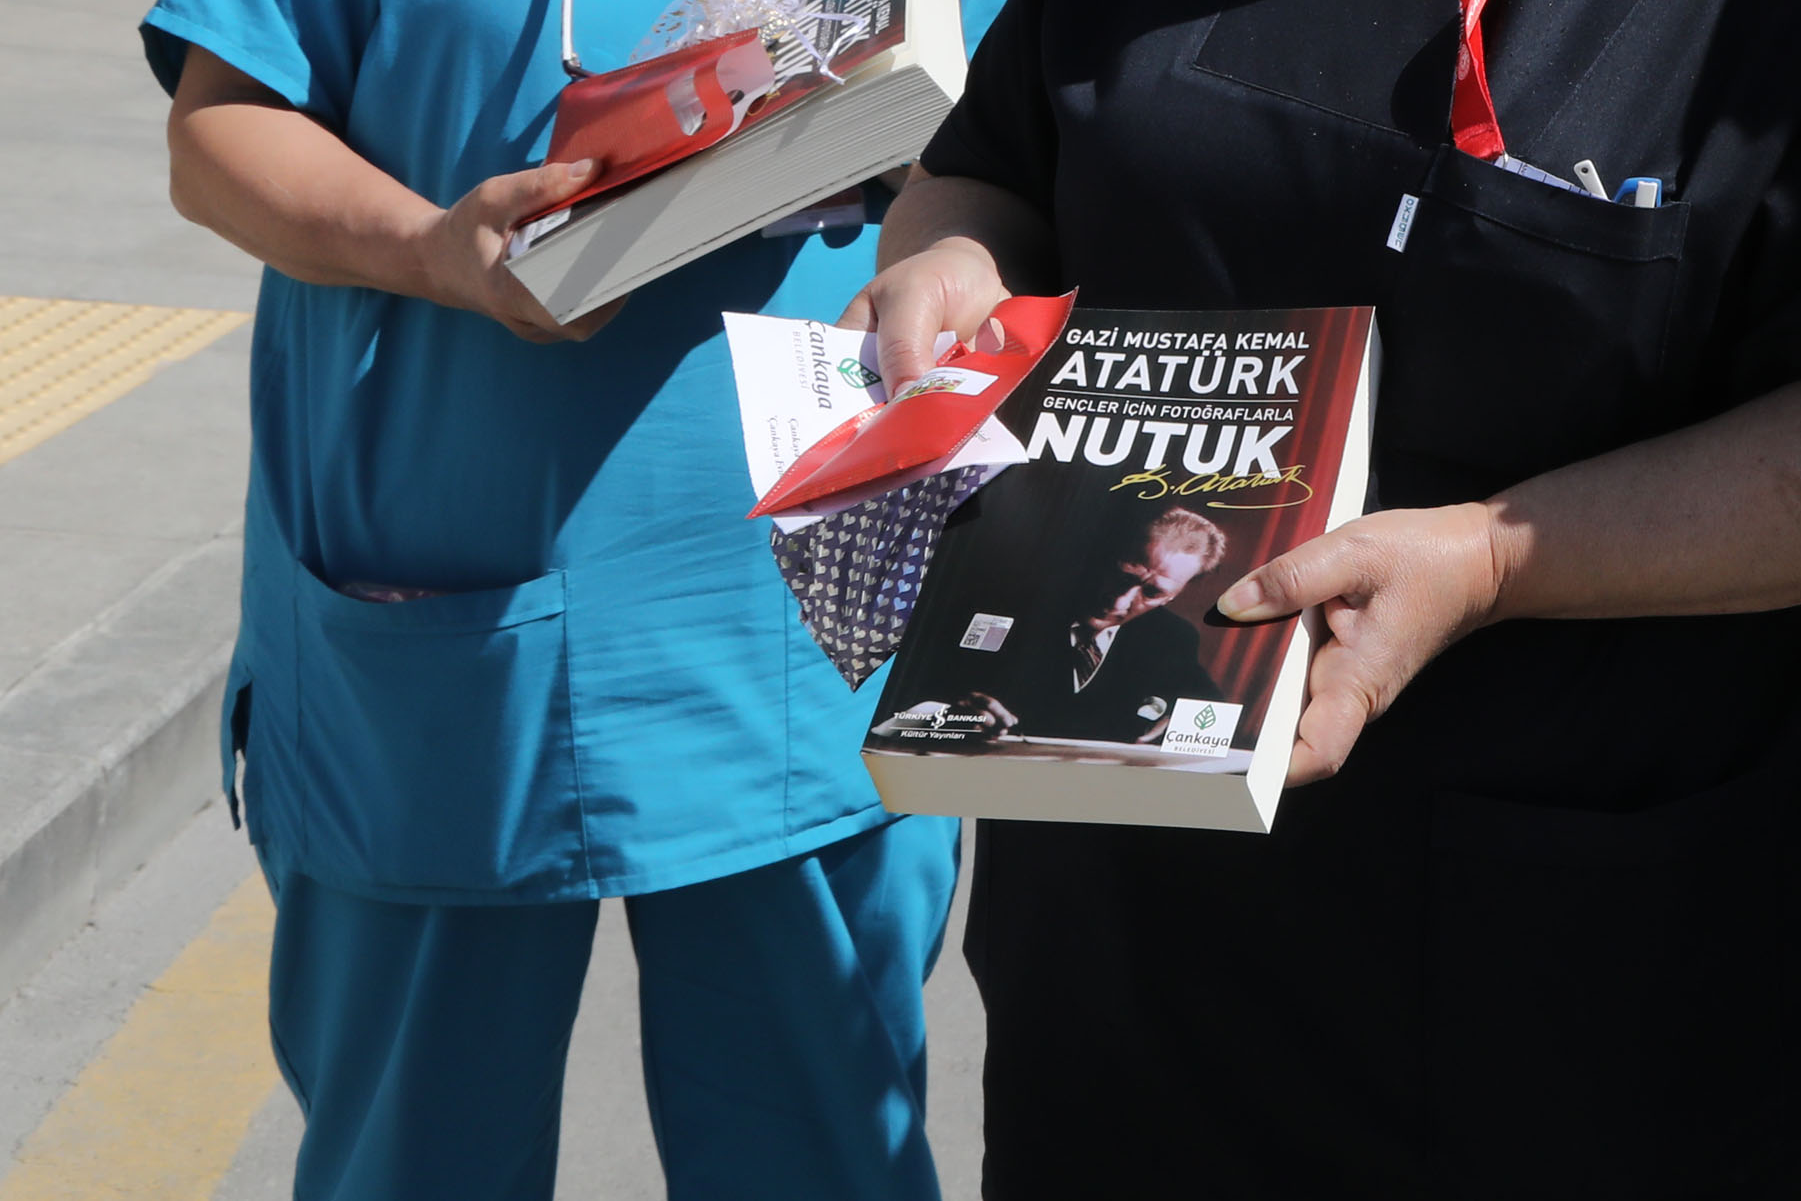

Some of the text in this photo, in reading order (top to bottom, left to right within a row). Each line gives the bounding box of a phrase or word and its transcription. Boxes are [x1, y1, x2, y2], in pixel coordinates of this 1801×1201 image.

[1066, 326, 1310, 350] GAZİ MUSTAFA KEMAL
[804, 319, 833, 410] Çankaya
[1050, 350, 1306, 395] ATATÜRK
[1043, 396, 1294, 422] GENÇLER İÇİN FOTOĞRAFLARLA
[1029, 411, 1294, 479] NUTUK
[893, 711, 932, 721] TÜRKİYE
[946, 714, 987, 723] BANKASI
[900, 730, 966, 740] Kültür Yayınları
[1166, 730, 1230, 748] Çankaya
